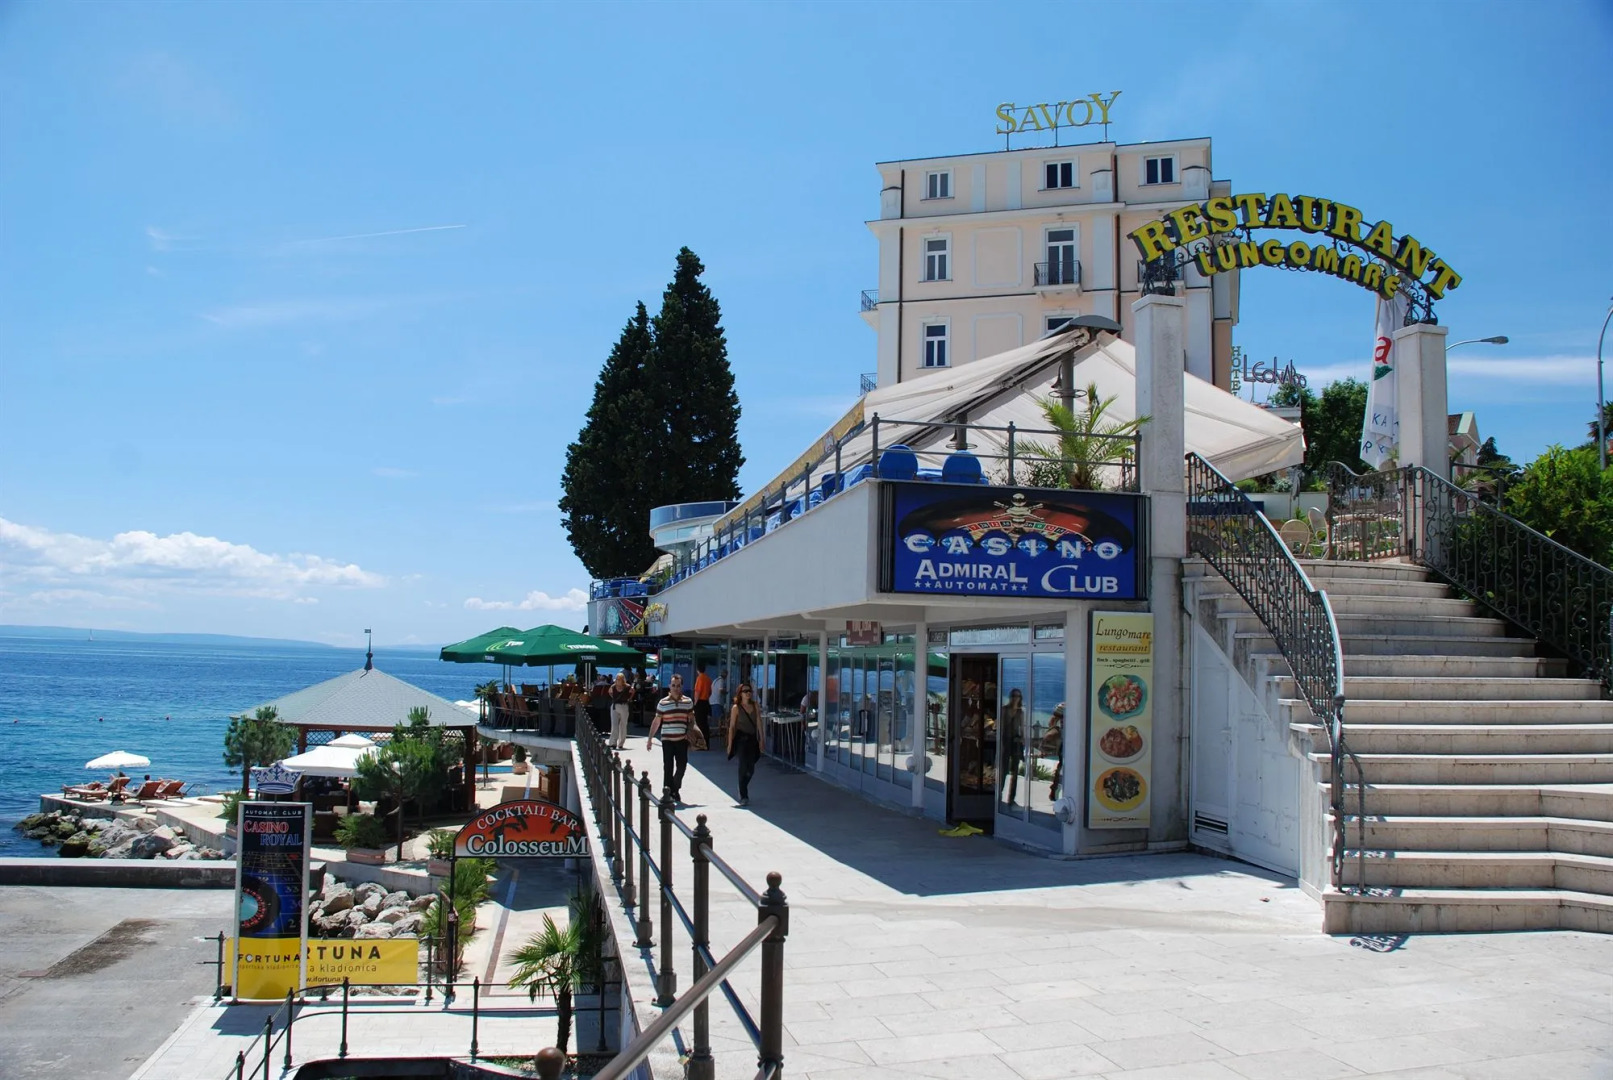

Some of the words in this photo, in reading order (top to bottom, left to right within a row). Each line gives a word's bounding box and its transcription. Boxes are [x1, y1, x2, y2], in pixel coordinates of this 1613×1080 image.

[996, 90, 1122, 134] SAVOY
[1127, 192, 1463, 301] RESTAURANT
[903, 532, 1122, 561] CASINO
[934, 580, 1008, 591] AUTOMAT
[1041, 565, 1119, 593] CLUB
[243, 820, 290, 834] CASINO
[476, 804, 548, 830] COCKTAIL
[550, 809, 579, 831] BAR
[260, 834, 303, 847] ROYAL
[467, 834, 589, 855] ColosseuM
[238, 953, 301, 963] FORTUNA
[320, 963, 377, 972] kladionica
